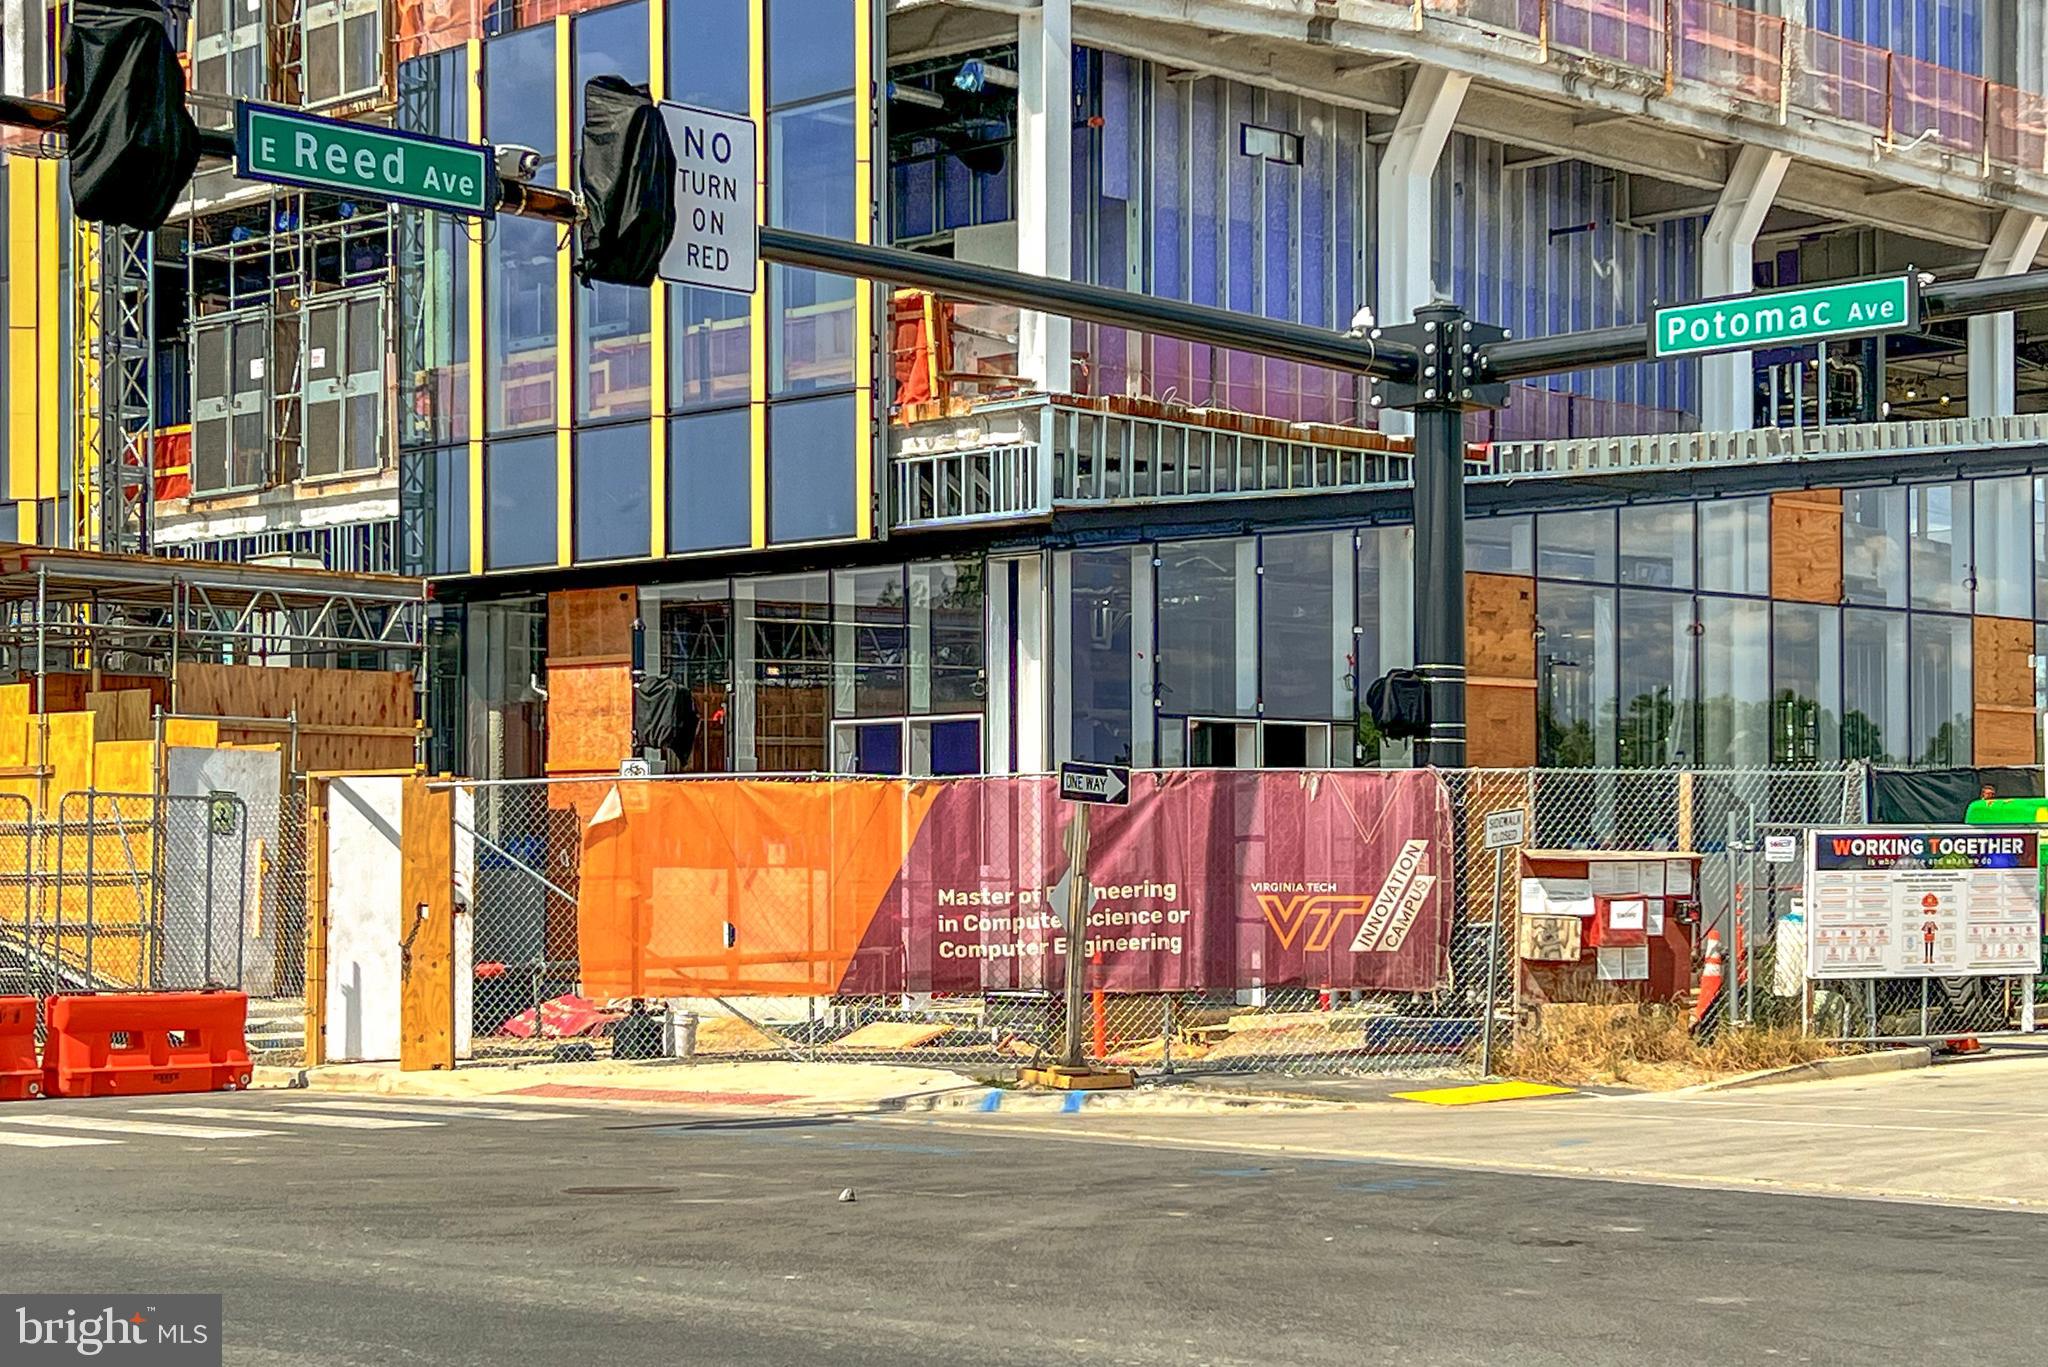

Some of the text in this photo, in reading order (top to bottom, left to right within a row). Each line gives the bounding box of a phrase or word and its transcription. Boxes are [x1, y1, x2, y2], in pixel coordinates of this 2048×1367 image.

[684, 125, 732, 164] NO
[261, 131, 474, 197] E Reed Ave
[678, 168, 737, 202] TURN
[692, 207, 724, 236] ON
[687, 242, 729, 272] RED
[1667, 300, 1895, 346] Potomac Ave
[1065, 773, 1107, 793] ONE WAY
[1489, 814, 1522, 829] SIDEWALK
[1491, 829, 1518, 844] CLOSED
[1832, 837, 2024, 856] WORKING TOGETHER
[938, 880, 1177, 906] Master of neering
[1250, 882, 1337, 893] VIRGINIA TECH
[1357, 844, 1421, 948] INNOVATION
[938, 914, 959, 933] in
[963, 911, 1063, 935] Compute
[1167, 909, 1192, 925] or
[1256, 895, 1374, 951] VT
[1385, 879, 1429, 948] CAMPUS
[939, 932, 1183, 961] Computer Egineering
